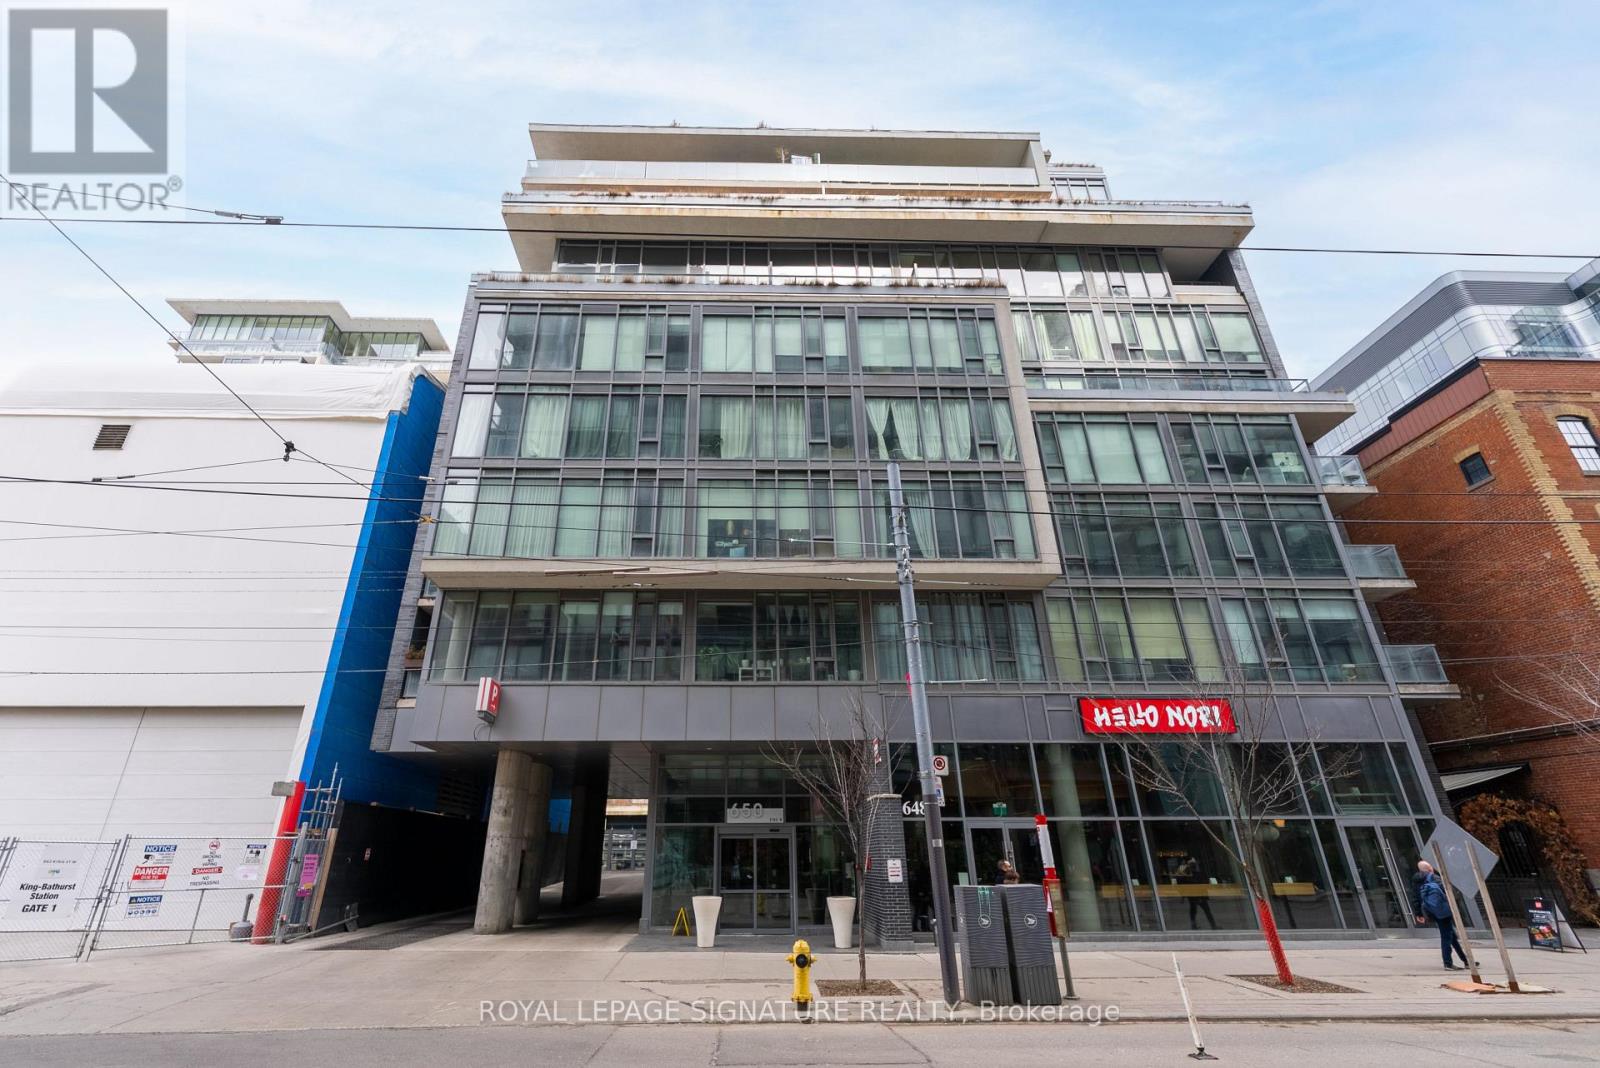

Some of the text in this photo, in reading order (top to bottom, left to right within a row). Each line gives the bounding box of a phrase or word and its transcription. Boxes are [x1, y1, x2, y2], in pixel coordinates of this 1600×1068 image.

[492, 685, 498, 701] P
[1094, 702, 1222, 728] HELLO NORI
[730, 803, 763, 818] 650
[902, 800, 925, 815] 648
[134, 867, 170, 875] DANGER
[19, 883, 76, 892] King-Bathurst
[30, 892, 59, 900] Station
[21, 904, 57, 913] GATE 1
